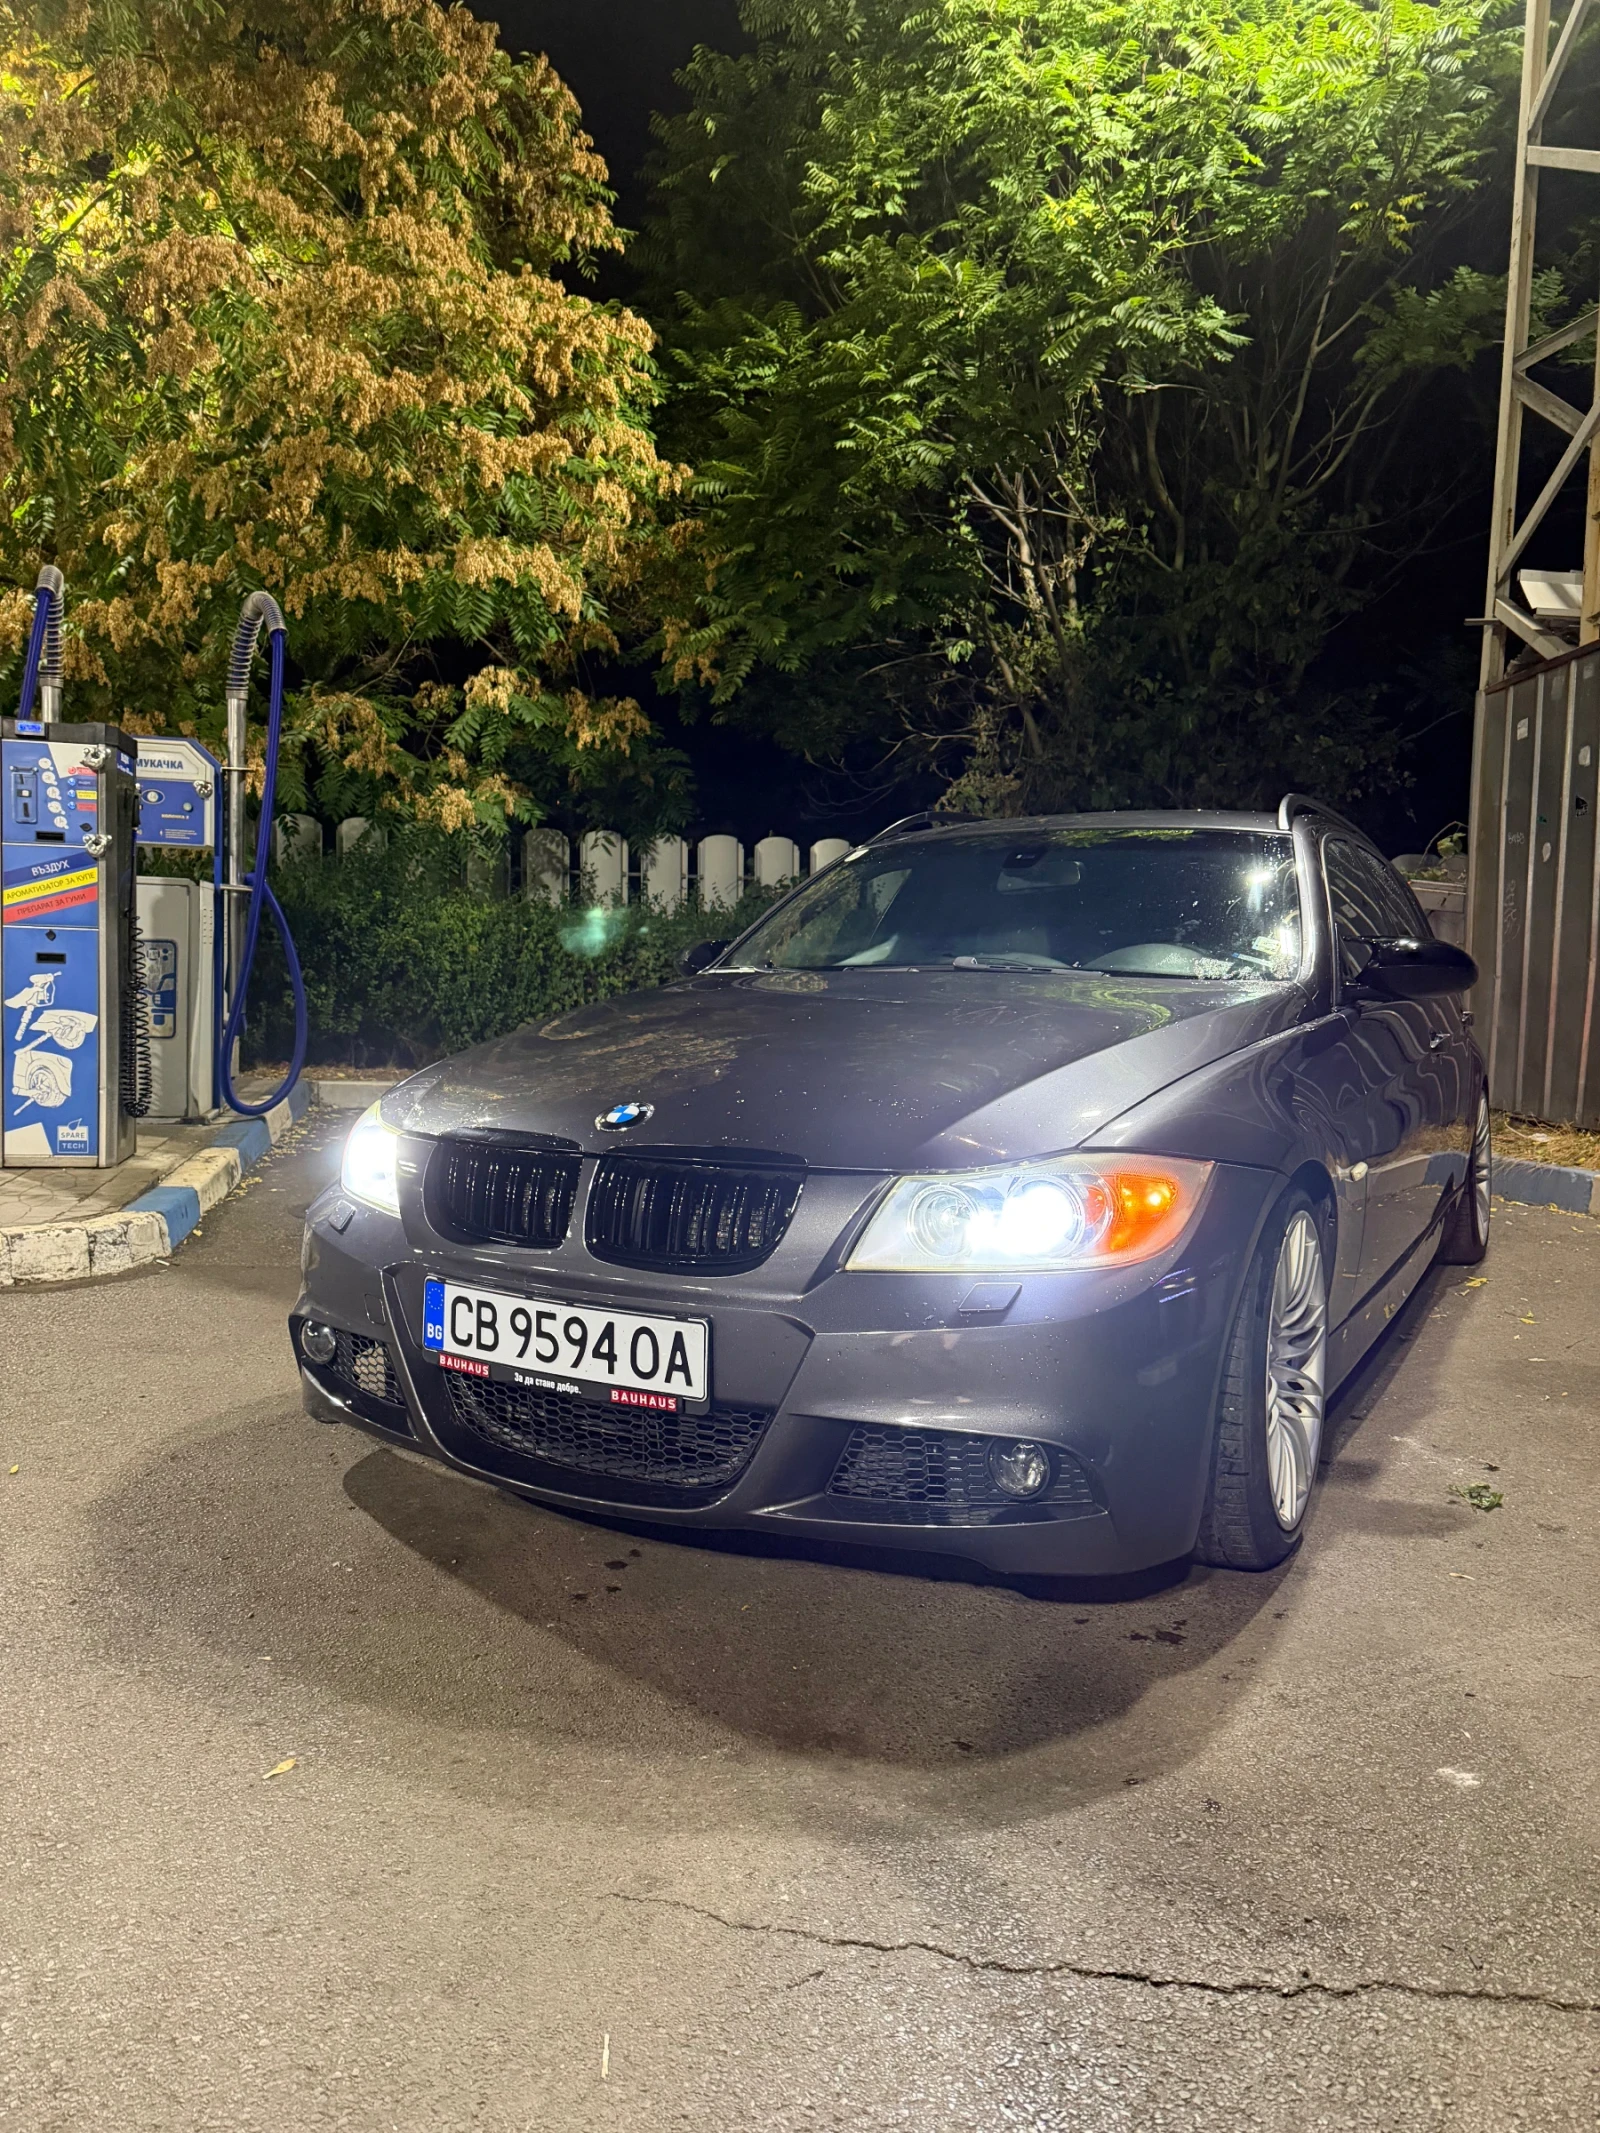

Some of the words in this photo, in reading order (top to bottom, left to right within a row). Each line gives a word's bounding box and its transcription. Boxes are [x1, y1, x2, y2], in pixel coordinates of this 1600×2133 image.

[31, 860, 70, 877] ВЪЗДУХ
[6, 880, 64, 900] АРОМАТИЗАТОР
[66, 877, 76, 885] ЗА
[77, 871, 96, 882] КУПЕ
[17, 902, 53, 915] ПРЕПАРАТ
[56, 898, 64, 907] ЗА
[66, 893, 86, 903] ГУМИ
[426, 1322, 443, 1341] BG
[450, 1295, 500, 1351] CB
[510, 1307, 618, 1375] 9594
[630, 1326, 693, 1387] OA
[439, 1354, 489, 1376] BAUHAUS
[514, 1372, 524, 1383] За
[524, 1376, 534, 1386] да
[535, 1378, 555, 1389] стане
[610, 1389, 677, 1410] BAUHAUS
